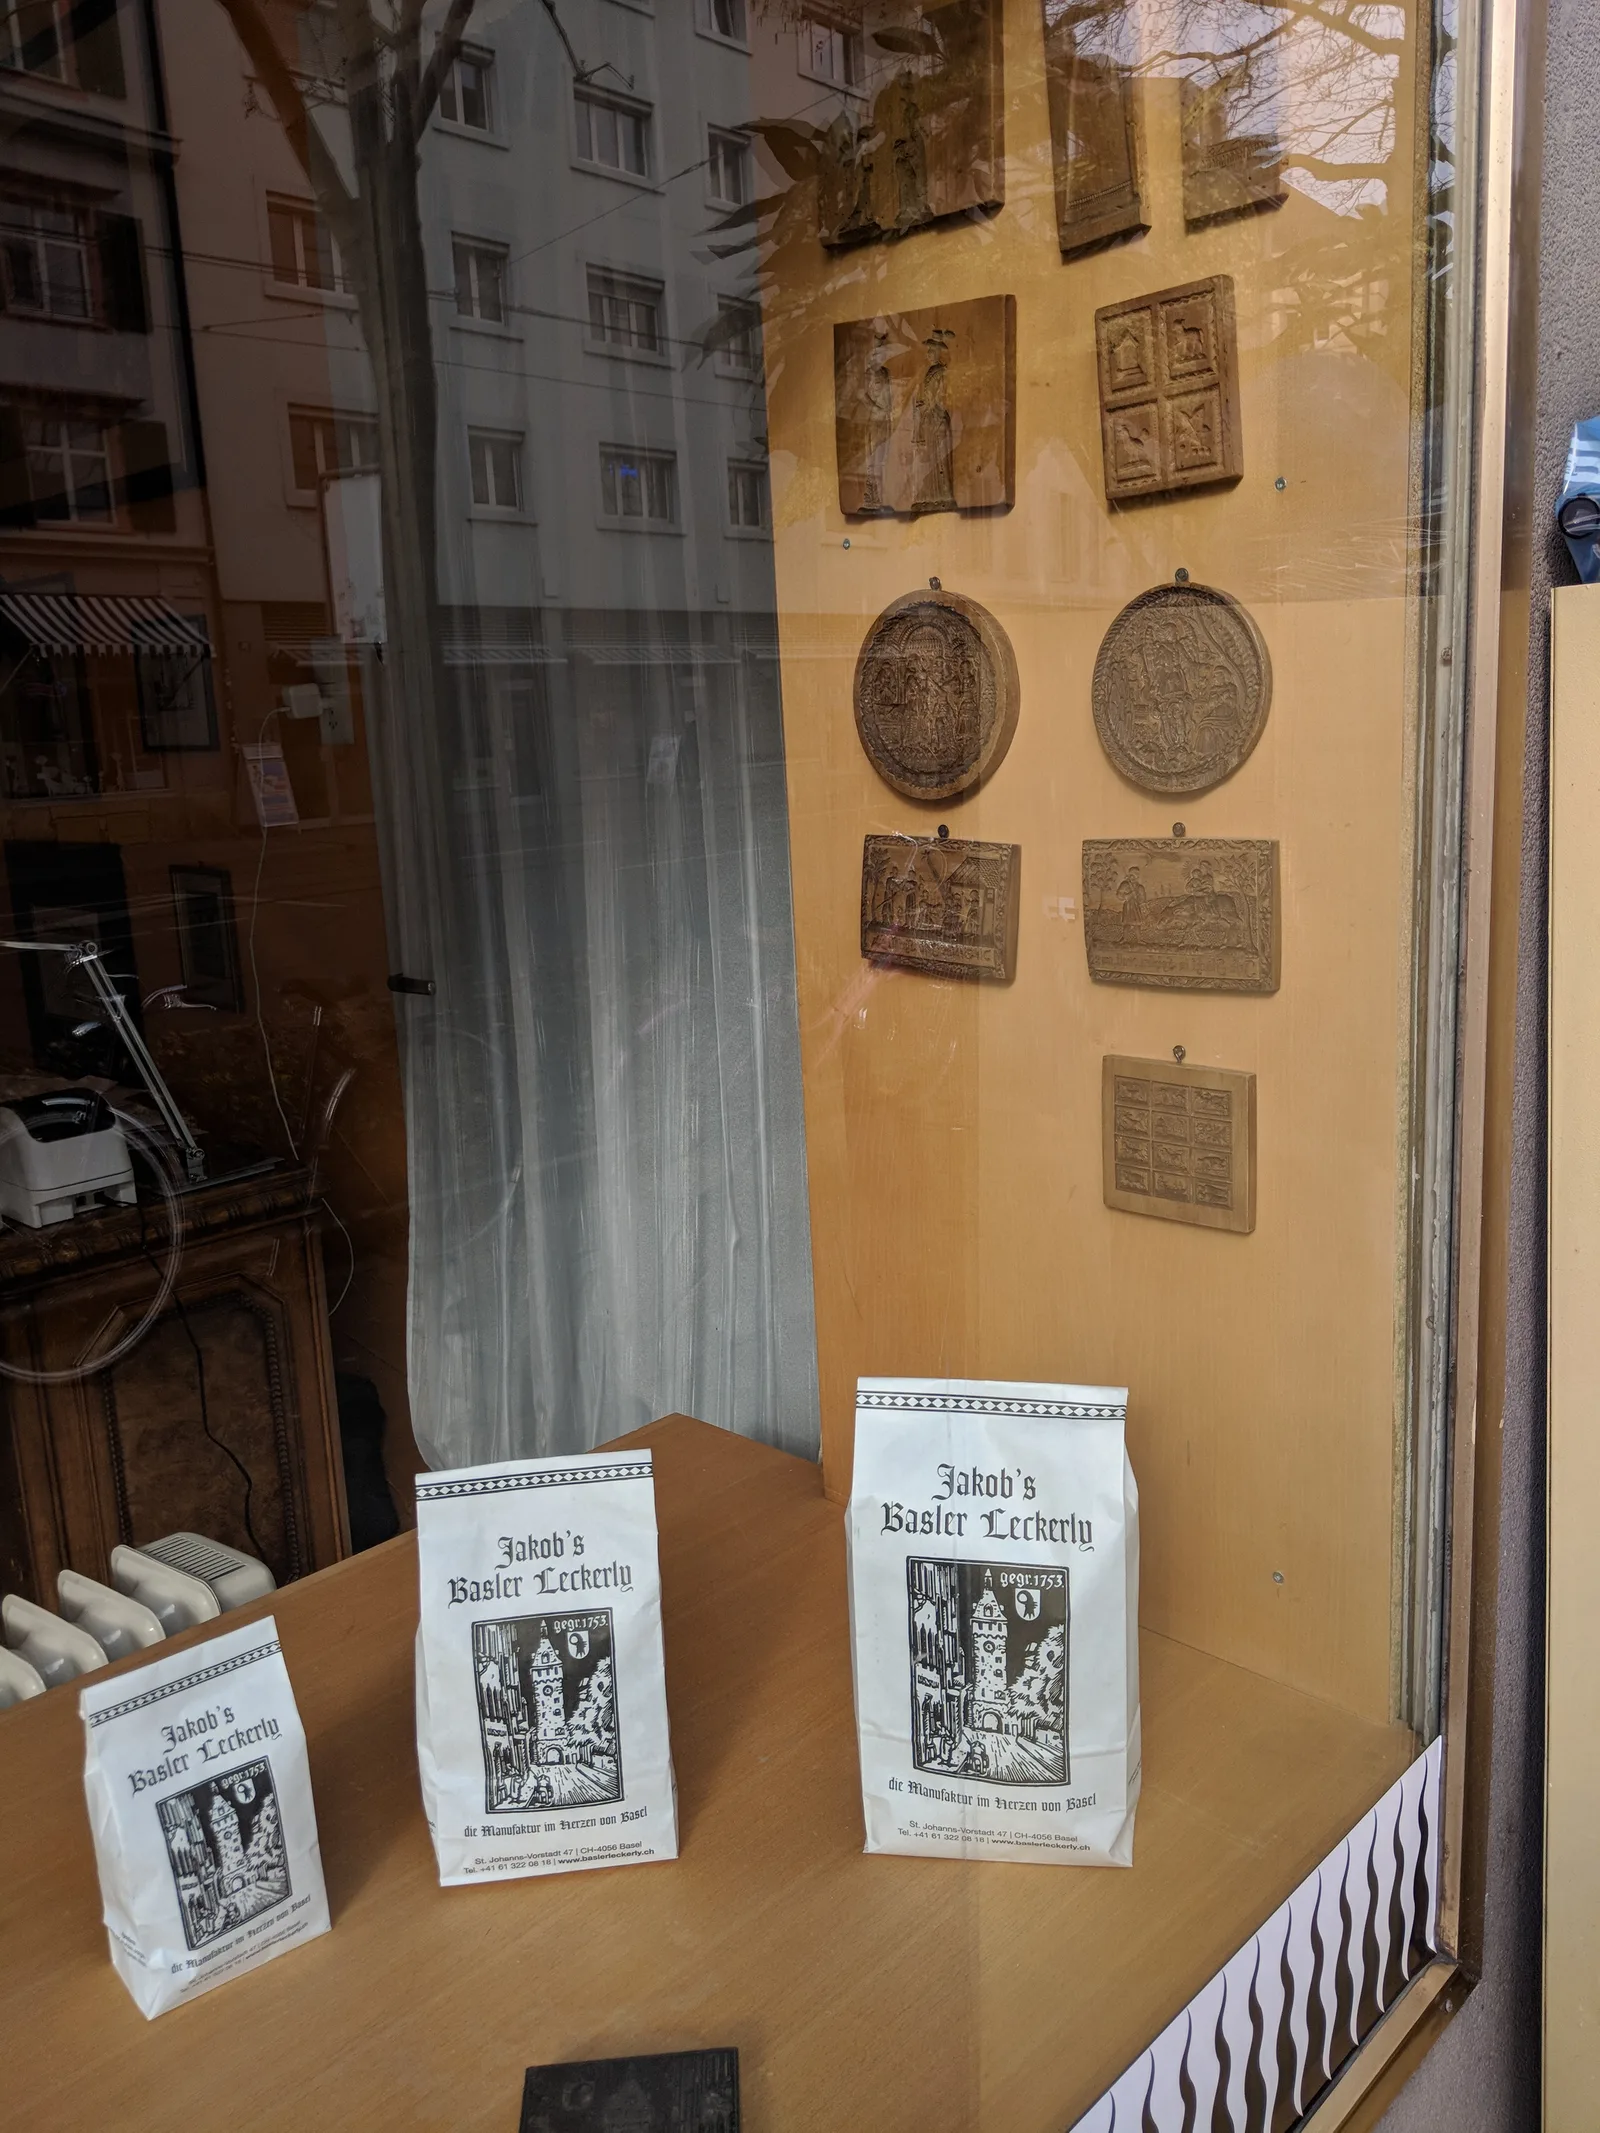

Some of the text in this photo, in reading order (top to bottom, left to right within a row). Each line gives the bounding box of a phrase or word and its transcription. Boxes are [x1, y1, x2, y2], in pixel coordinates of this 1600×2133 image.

[931, 1463, 1037, 1500] Jakob's
[880, 1501, 1095, 1552] Basler Leckerly
[494, 1530, 585, 1570] Jakob's
[447, 1560, 634, 1609] Basler Leckerly
[161, 1705, 235, 1755] Jakob's
[127, 1717, 283, 1797] Basler Leckerly
[888, 1777, 904, 1791] die
[908, 1781, 974, 1806] Manufaktur
[977, 1794, 990, 1808] im
[1066, 1793, 1096, 1813] Basel
[464, 1825, 478, 1838] die
[481, 1823, 541, 1837] Manufaktur
[544, 1821, 556, 1832] im
[620, 1806, 648, 1824] Basel
[898, 1828, 911, 1837] Tel.
[913, 1831, 929, 1839] +41
[944, 1833, 959, 1841] 322
[909, 1820, 920, 1829] St.
[997, 1830, 1007, 1838] 47
[1014, 1832, 1052, 1841] CH-4056
[1054, 1834, 1078, 1843] Basel
[464, 1867, 477, 1875] Tel.
[480, 1864, 496, 1873] +41
[510, 1861, 526, 1869] 322
[475, 1857, 487, 1865] St.
[580, 1844, 618, 1855] CH-4056
[619, 1841, 643, 1850] Basel
